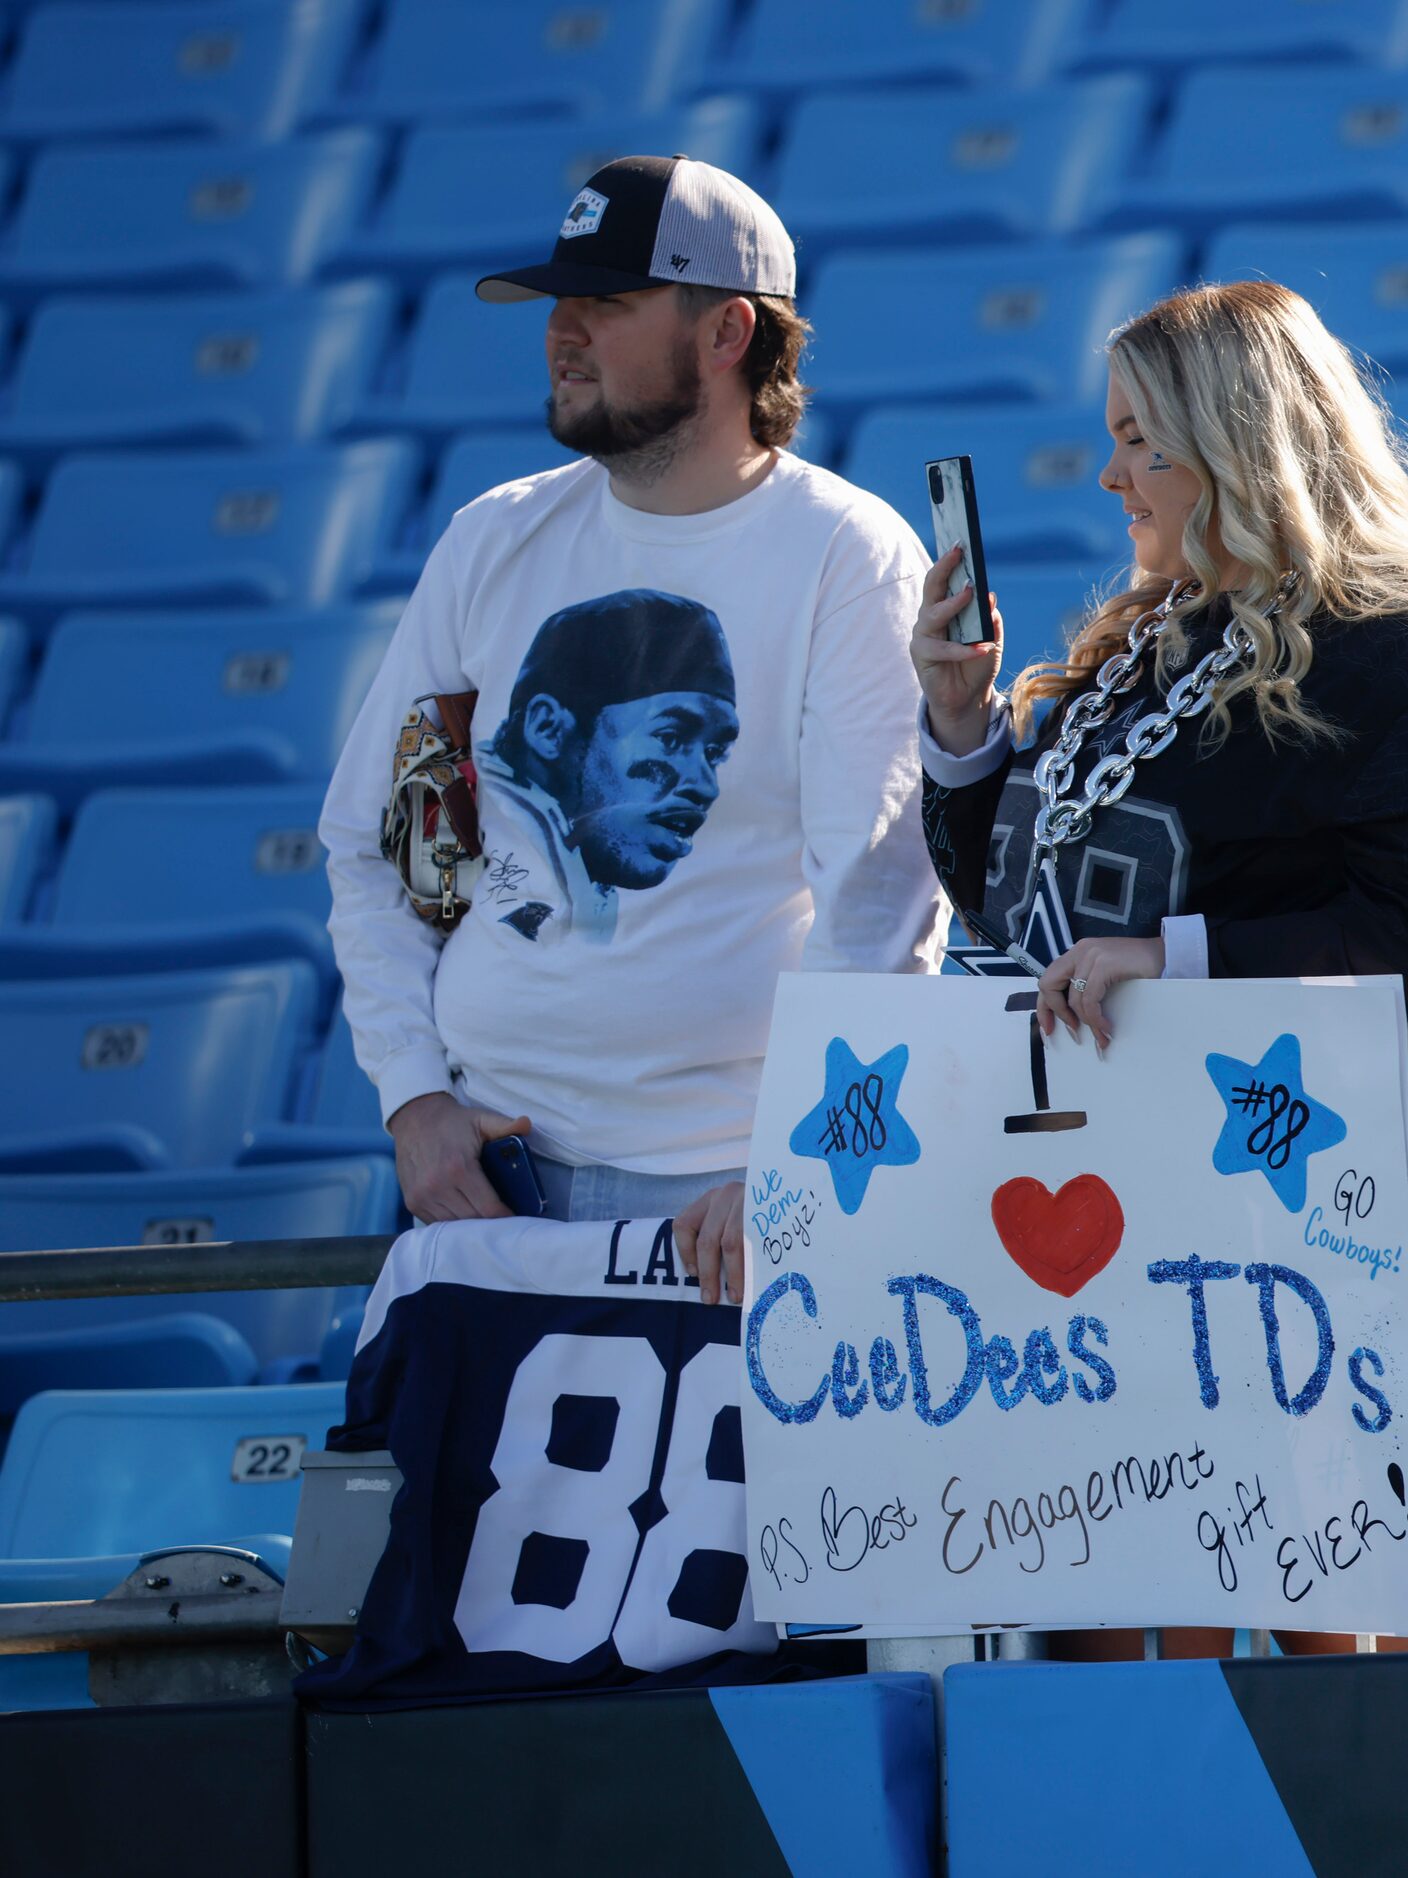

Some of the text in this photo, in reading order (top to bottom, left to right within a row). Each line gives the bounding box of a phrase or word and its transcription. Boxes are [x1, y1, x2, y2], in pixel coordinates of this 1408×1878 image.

[96, 1028, 136, 1063] 20
[1004, 990, 1088, 1134] I
[817, 1073, 888, 1158] #88
[1231, 1079, 1311, 1170] #88
[751, 1188, 803, 1237] Dem
[1334, 1169, 1375, 1226] GO
[604, 1218, 706, 1286] LA
[1304, 1206, 1402, 1281] Cowboys!
[746, 1271, 1118, 1428] CeeDees
[247, 1445, 291, 1475] 22
[452, 1333, 779, 1674] 88
[760, 1439, 1215, 1592] P.S. Best Engagement
[1197, 1473, 1274, 1593] gift
